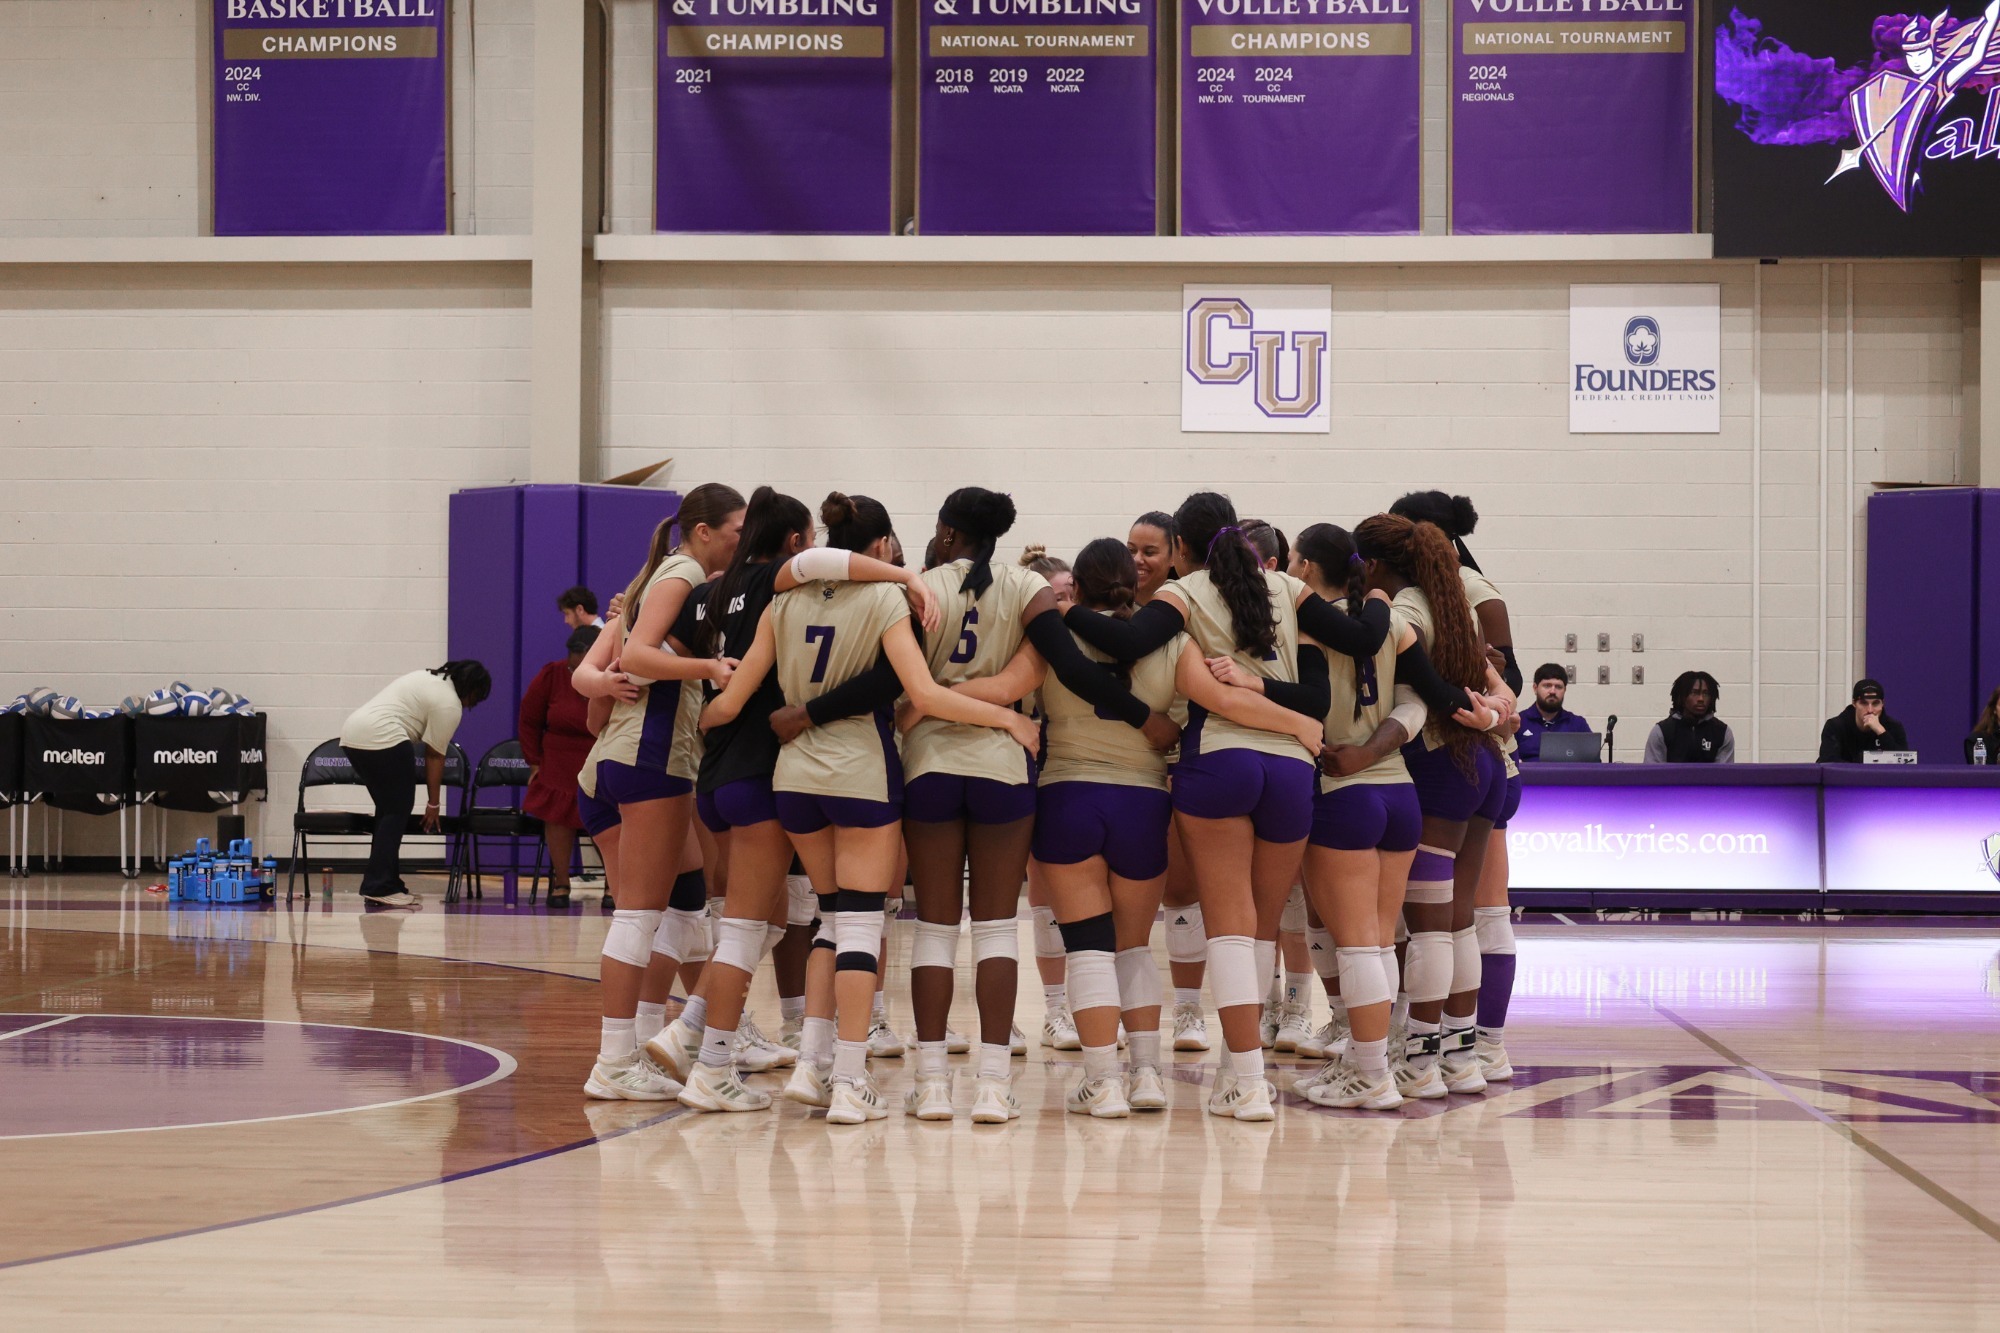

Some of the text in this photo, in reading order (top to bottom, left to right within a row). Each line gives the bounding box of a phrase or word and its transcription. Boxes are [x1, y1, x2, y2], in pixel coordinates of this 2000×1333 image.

[262, 35, 397, 53] CHAMPIONS
[706, 33, 843, 50] CHAMPIONS
[941, 35, 1135, 47] NATIONAL TOURNAMENT
[1231, 32, 1370, 49] CHAMPIONS
[1475, 31, 1672, 45] NATIONAL TOURNAMENT
[225, 66, 261, 81] 2024
[675, 69, 711, 83] 2021
[935, 68, 974, 83] 2018
[989, 68, 1028, 83] 2019
[1046, 68, 1085, 83] 2022
[1197, 67, 1236, 82] 2024
[1255, 67, 1293, 82] 2024
[1469, 65, 1507, 80] 2024
[236, 83, 250, 91] CC
[687, 85, 702, 94] CC
[940, 85, 969, 94] NCATA
[994, 85, 1023, 94] NCATA
[1050, 84, 1080, 93] NCATA
[1209, 84, 1223, 93] CC
[1267, 84, 1281, 92] CC
[1475, 82, 1501, 91] NCAA
[226, 94, 261, 102] NW. DIV.
[1198, 95, 1234, 104] NW. DIV.
[1242, 94, 1305, 103] TOURNAMENT
[1462, 92, 1514, 102] REGIONALS
[1186, 297, 1327, 418] CU
[805, 625, 836, 683] 7
[43, 748, 106, 765] molten
[153, 747, 218, 764] molten
[1510, 823, 1770, 860] govalkyries.com
